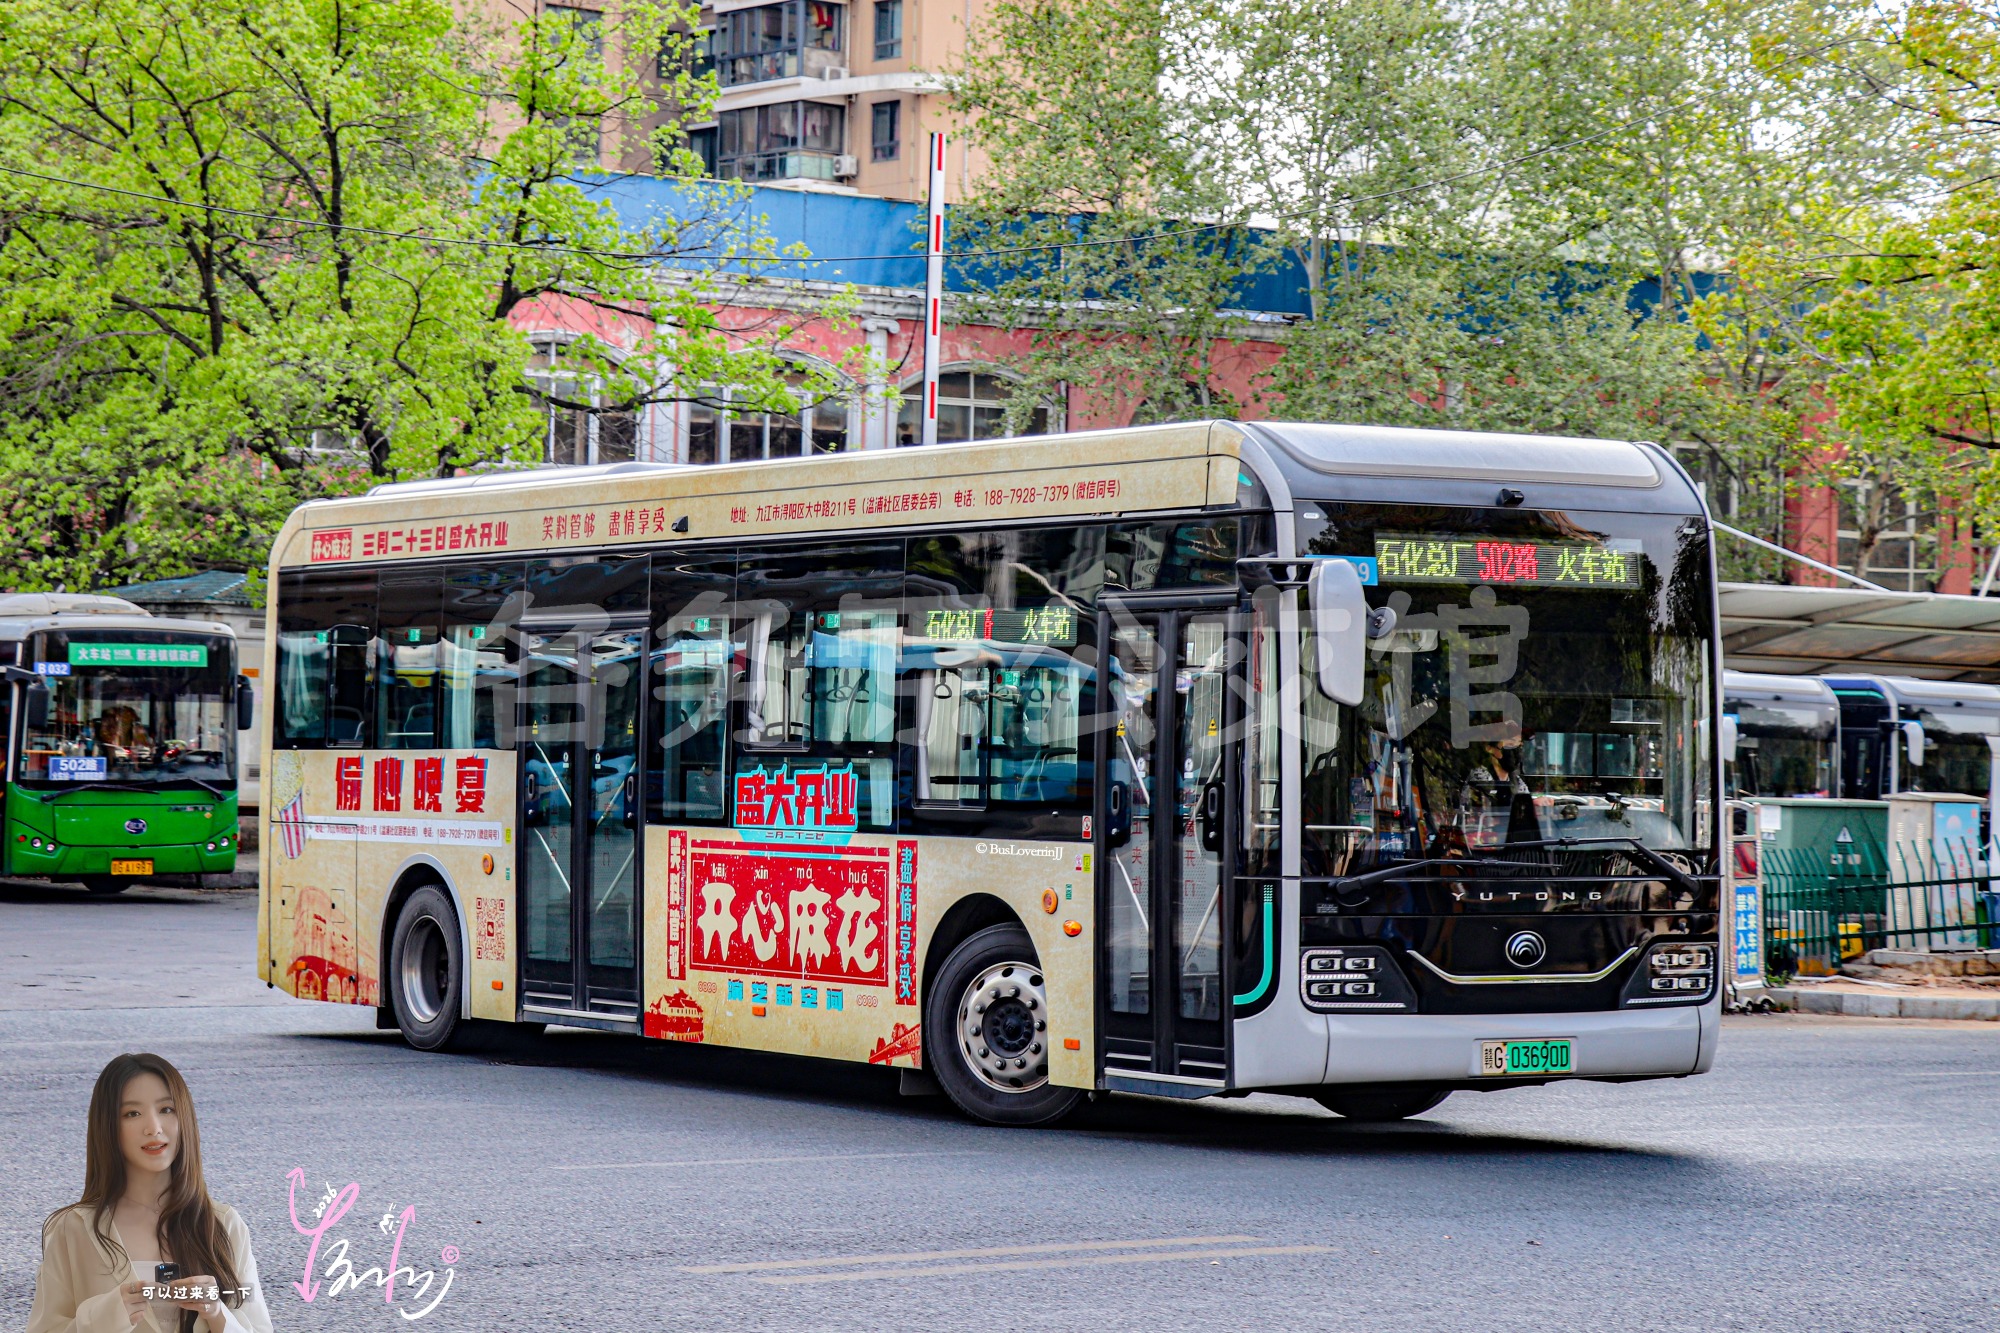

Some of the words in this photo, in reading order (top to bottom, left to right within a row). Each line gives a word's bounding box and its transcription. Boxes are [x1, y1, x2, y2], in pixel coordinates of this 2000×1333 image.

[362, 521, 509, 557] 三月二十三日盛大开业
[541, 513, 595, 541] 笑料管够
[313, 537, 351, 560] 开心麻花
[1376, 541, 1474, 577] 石化总厂
[1475, 541, 1539, 582] 502路
[1555, 545, 1626, 583] 火车站
[926, 608, 986, 642] 石化总厂
[1021, 606, 1071, 642] 火车站
[78, 647, 111, 660] 火车站
[60, 759, 97, 771] 502路
[735, 764, 858, 828] 盛大开业
[1450, 890, 1603, 902] YUTONG
[697, 882, 881, 973] 开心麻花
